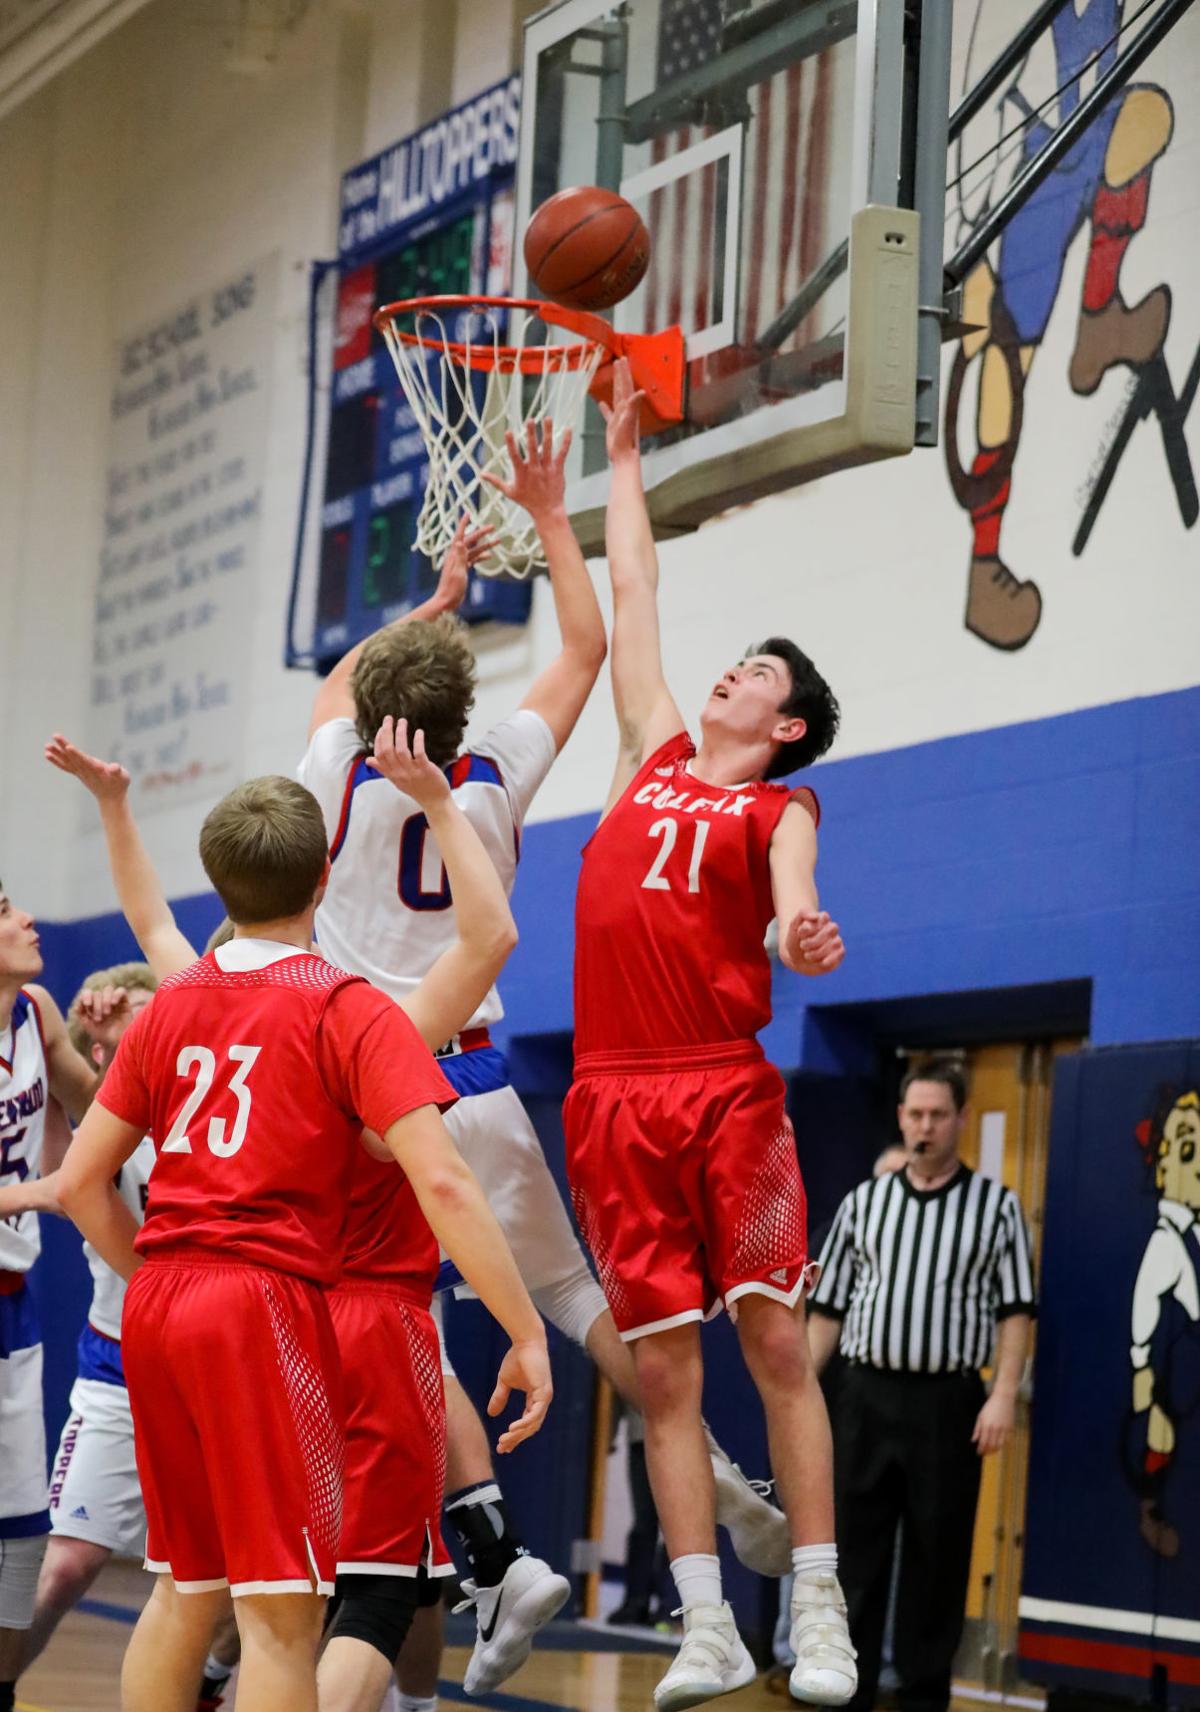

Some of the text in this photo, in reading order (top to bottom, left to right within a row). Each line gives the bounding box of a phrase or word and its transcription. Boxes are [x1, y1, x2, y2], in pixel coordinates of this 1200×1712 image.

[378, 77, 519, 231] HILLTOPPERS
[633, 782, 757, 816] COLFAX
[397, 811, 454, 912] 0
[640, 817, 710, 893] 21
[160, 1044, 263, 1158] 23
